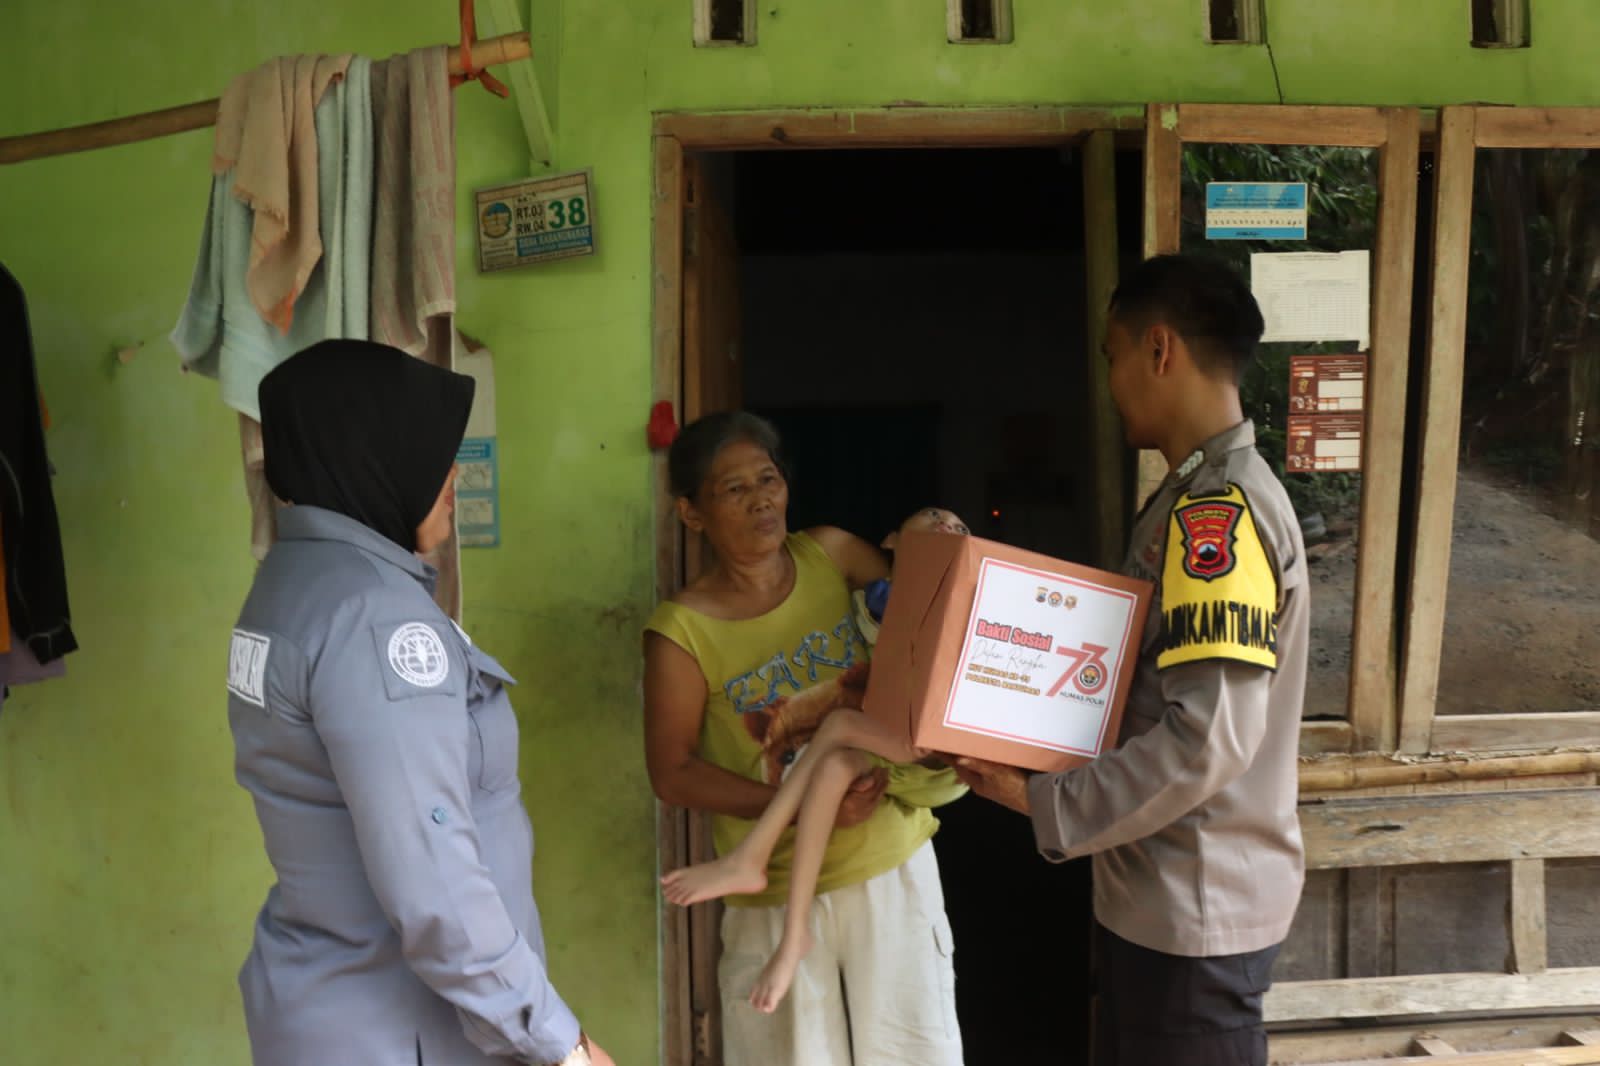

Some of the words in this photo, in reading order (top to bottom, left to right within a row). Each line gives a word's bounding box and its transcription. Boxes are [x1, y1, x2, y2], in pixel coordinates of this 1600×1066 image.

[547, 196, 586, 229] 38
[976, 618, 1012, 642] Bakti
[1010, 627, 1053, 652] Sosial
[1046, 642, 1109, 697] 73
